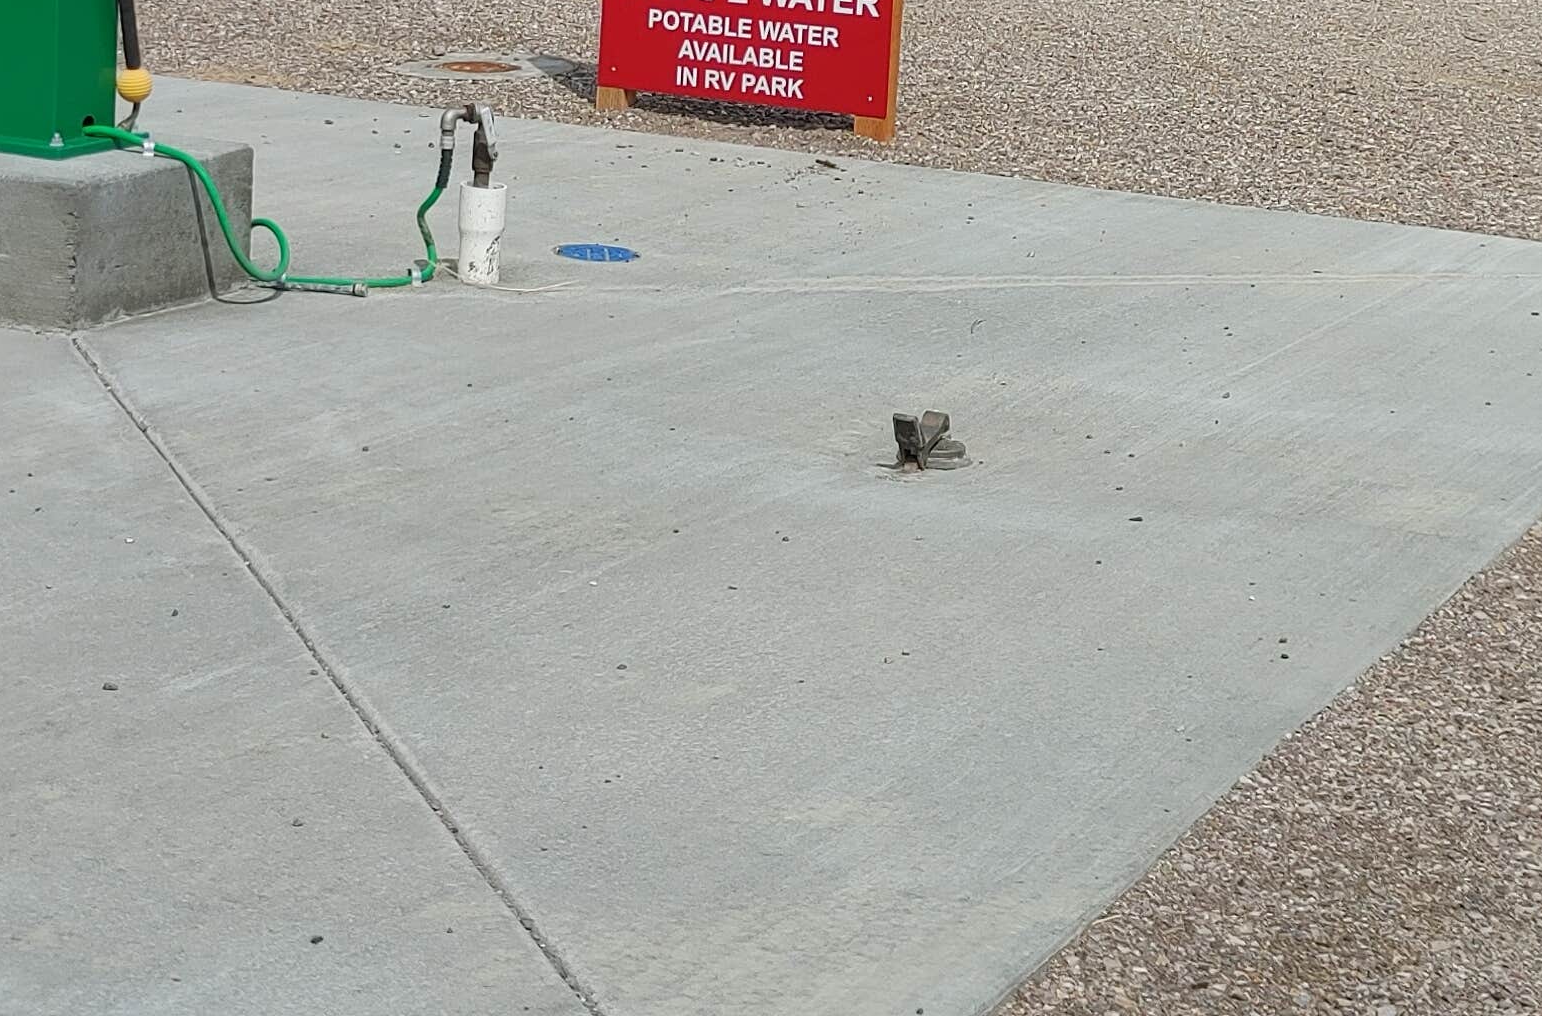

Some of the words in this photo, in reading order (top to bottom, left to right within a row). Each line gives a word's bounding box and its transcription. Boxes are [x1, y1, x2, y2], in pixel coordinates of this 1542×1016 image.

[648, 8, 753, 39] POTABLE
[758, 19, 839, 48] WATER
[677, 39, 804, 72] AVAILABLE
[676, 65, 698, 88] IN
[704, 69, 736, 91] RV
[741, 72, 804, 100] PARK
